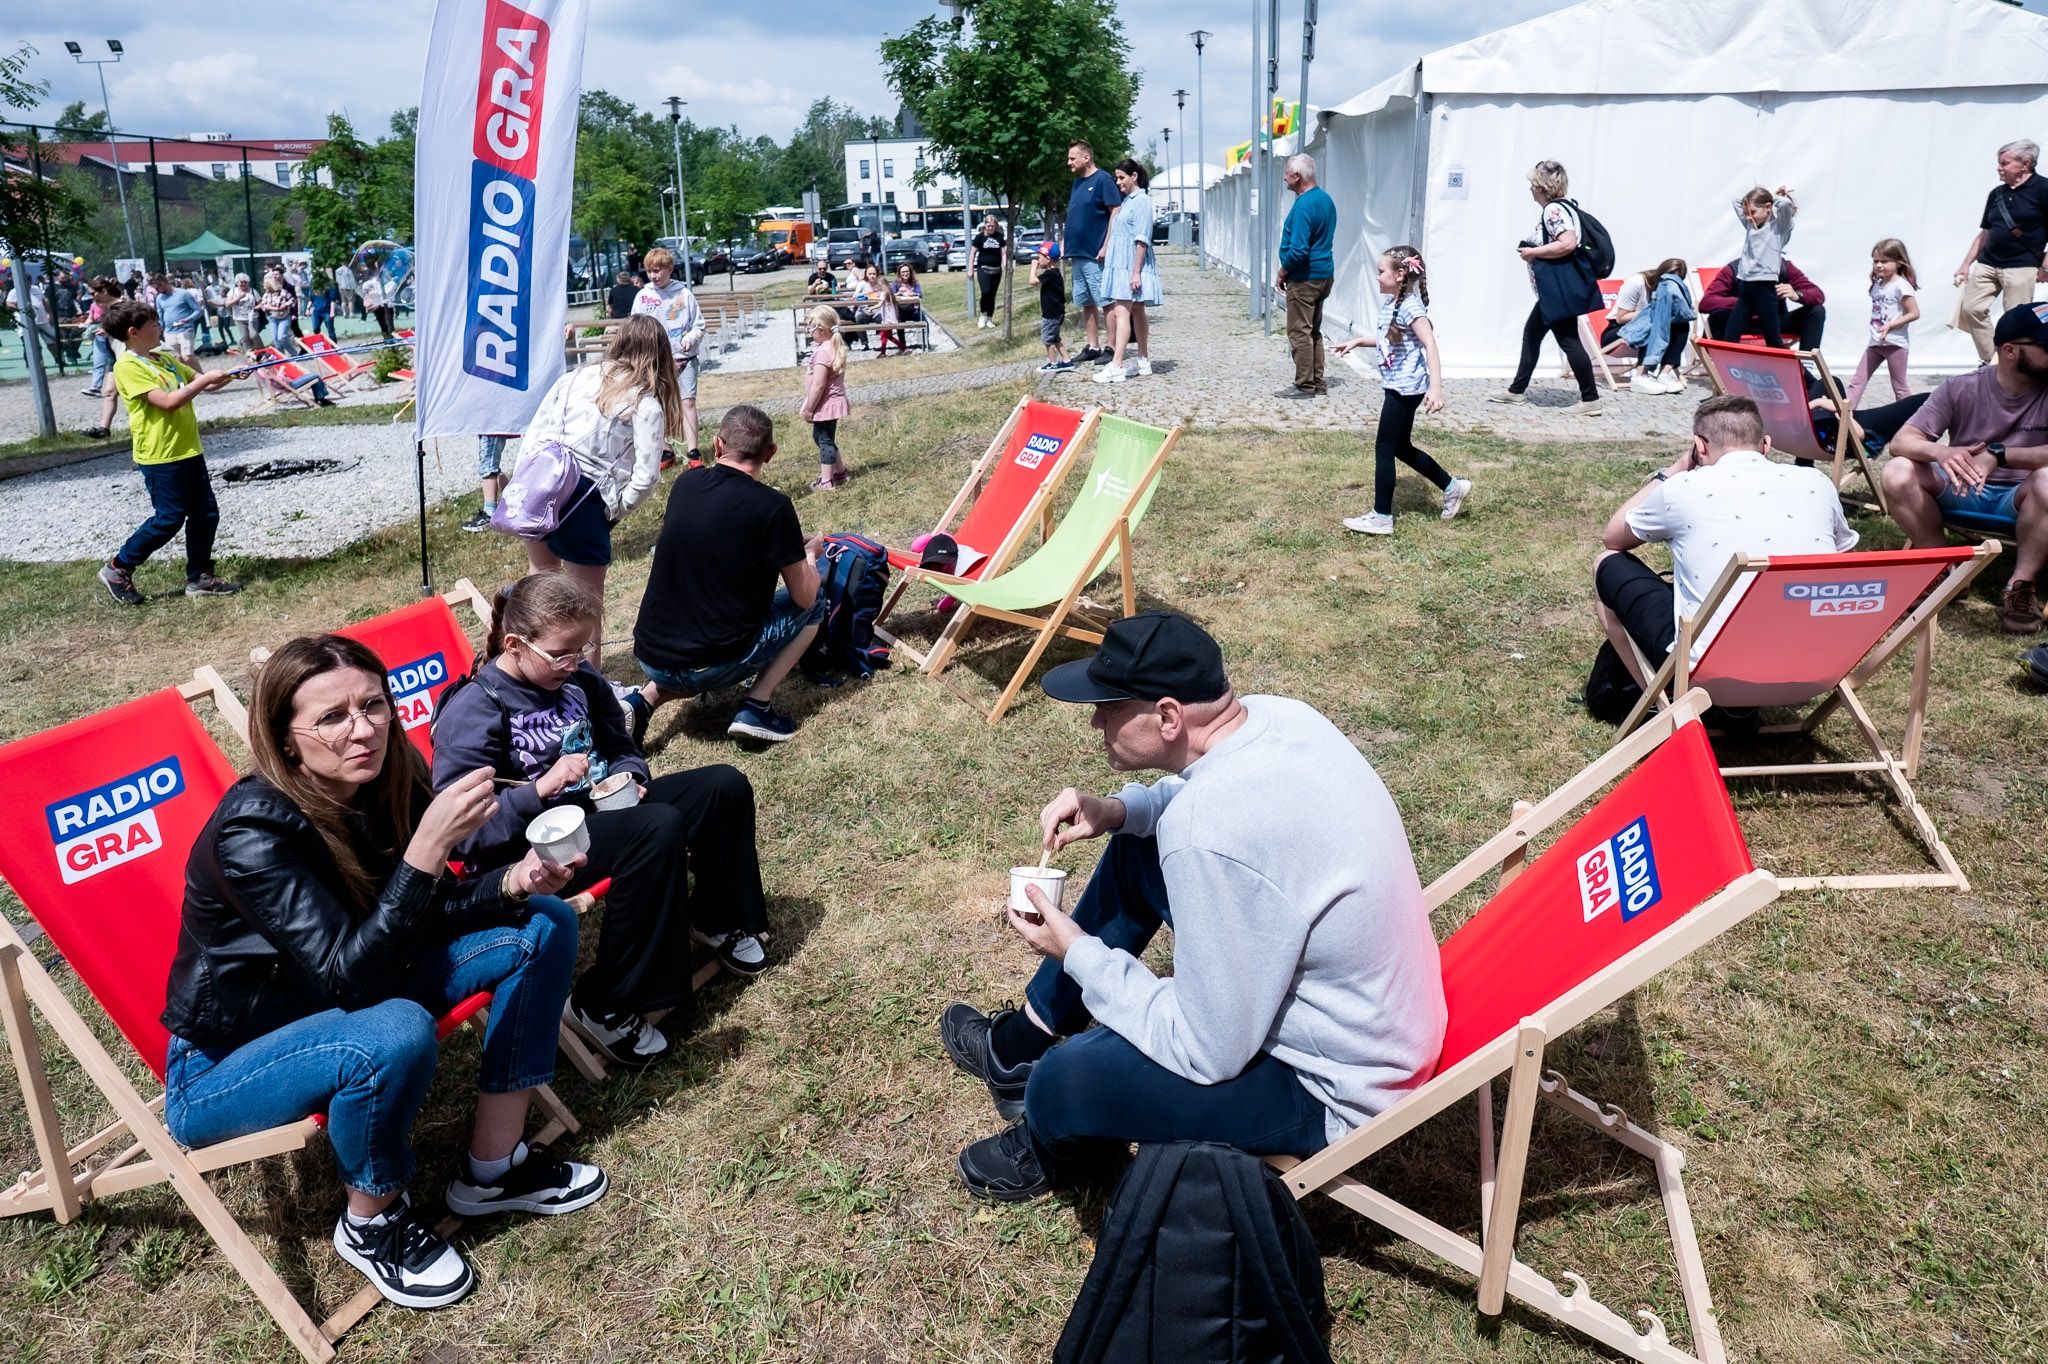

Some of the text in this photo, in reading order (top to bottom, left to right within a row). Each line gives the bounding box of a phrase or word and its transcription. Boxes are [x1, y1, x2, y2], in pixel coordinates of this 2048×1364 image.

[475, 27, 538, 378] RADIO GRA
[1020, 451, 1038, 466] GRA
[1028, 435, 1060, 453] RADIO
[387, 659, 443, 695] ADIO
[396, 698, 430, 723] RA
[54, 767, 177, 836] RADIO
[66, 822, 153, 871] GRA
[1616, 823, 1653, 912] RADIO
[1584, 850, 1612, 914] GRA
